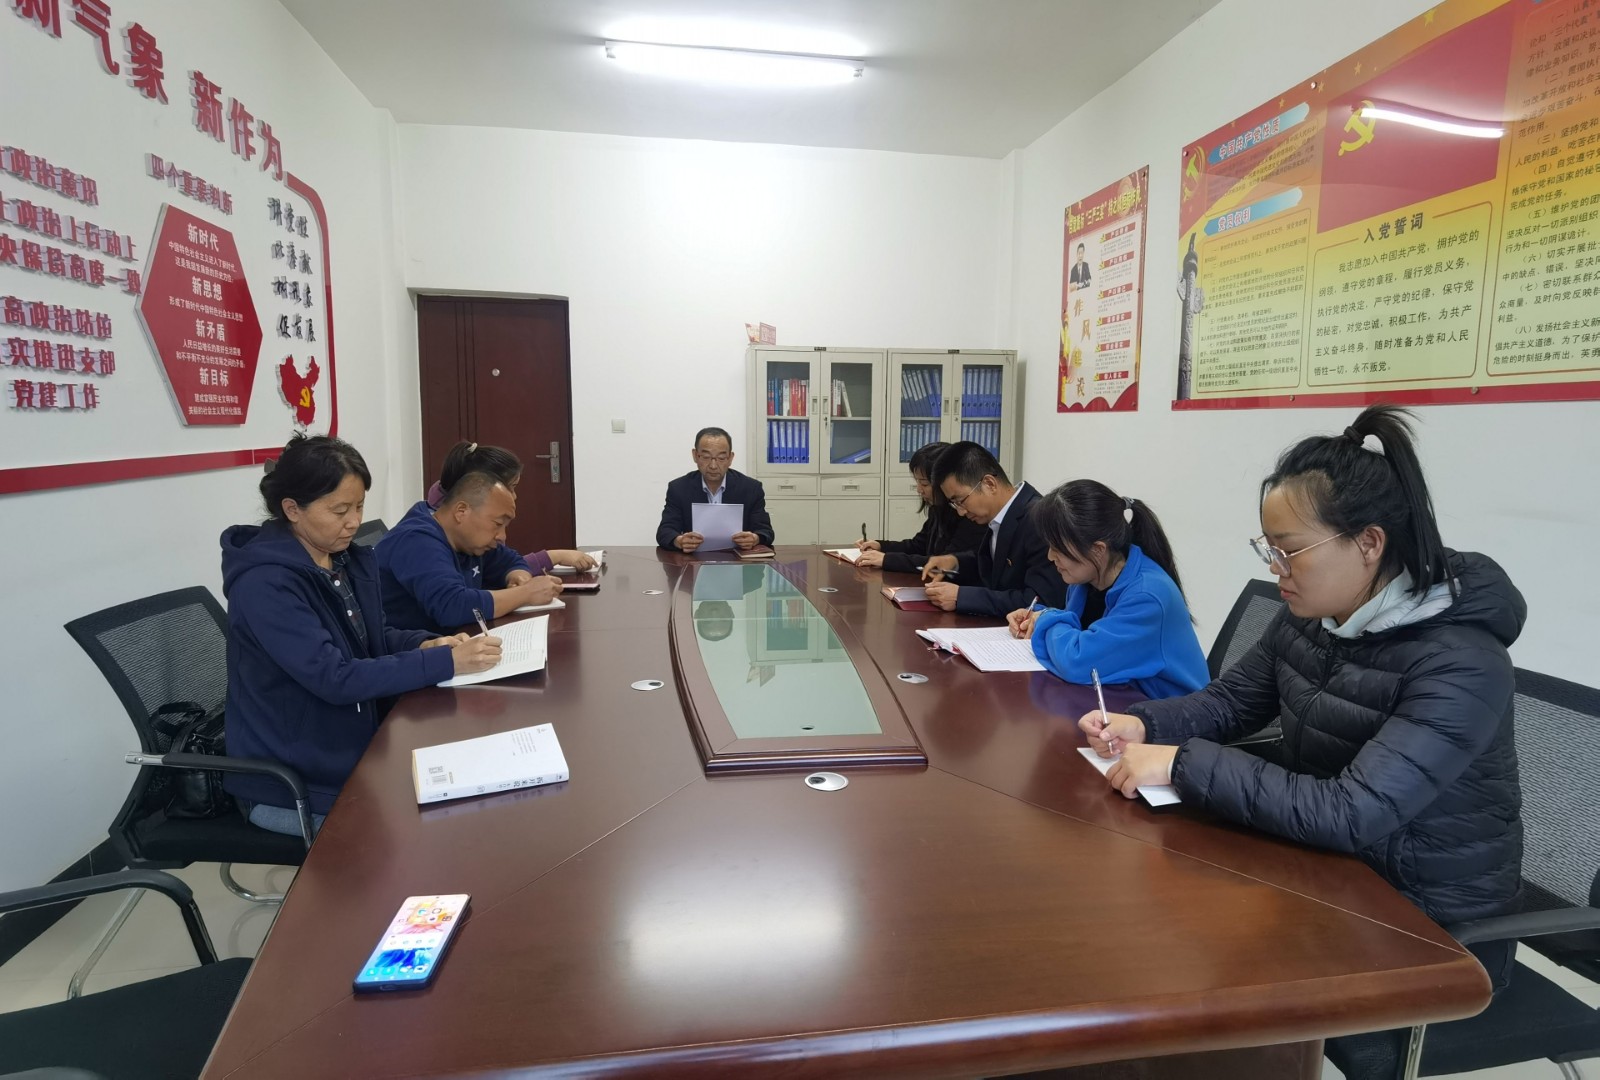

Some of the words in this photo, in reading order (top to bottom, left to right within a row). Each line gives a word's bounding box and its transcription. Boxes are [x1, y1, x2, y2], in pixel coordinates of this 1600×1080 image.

[190, 70, 285, 181] 新作为
[0, 146, 99, 205] 政治意识
[188, 223, 219, 252] 新时代
[1364, 212, 1424, 243] 入党誓词
[1522, 241, 1600, 263] （六）切实开展批
[192, 276, 223, 302] 新思想
[195, 318, 225, 342] 新矛盾
[0, 336, 115, 375] 实推进支部
[199, 367, 229, 387] 新目标
[10, 379, 100, 409] 党建工作
